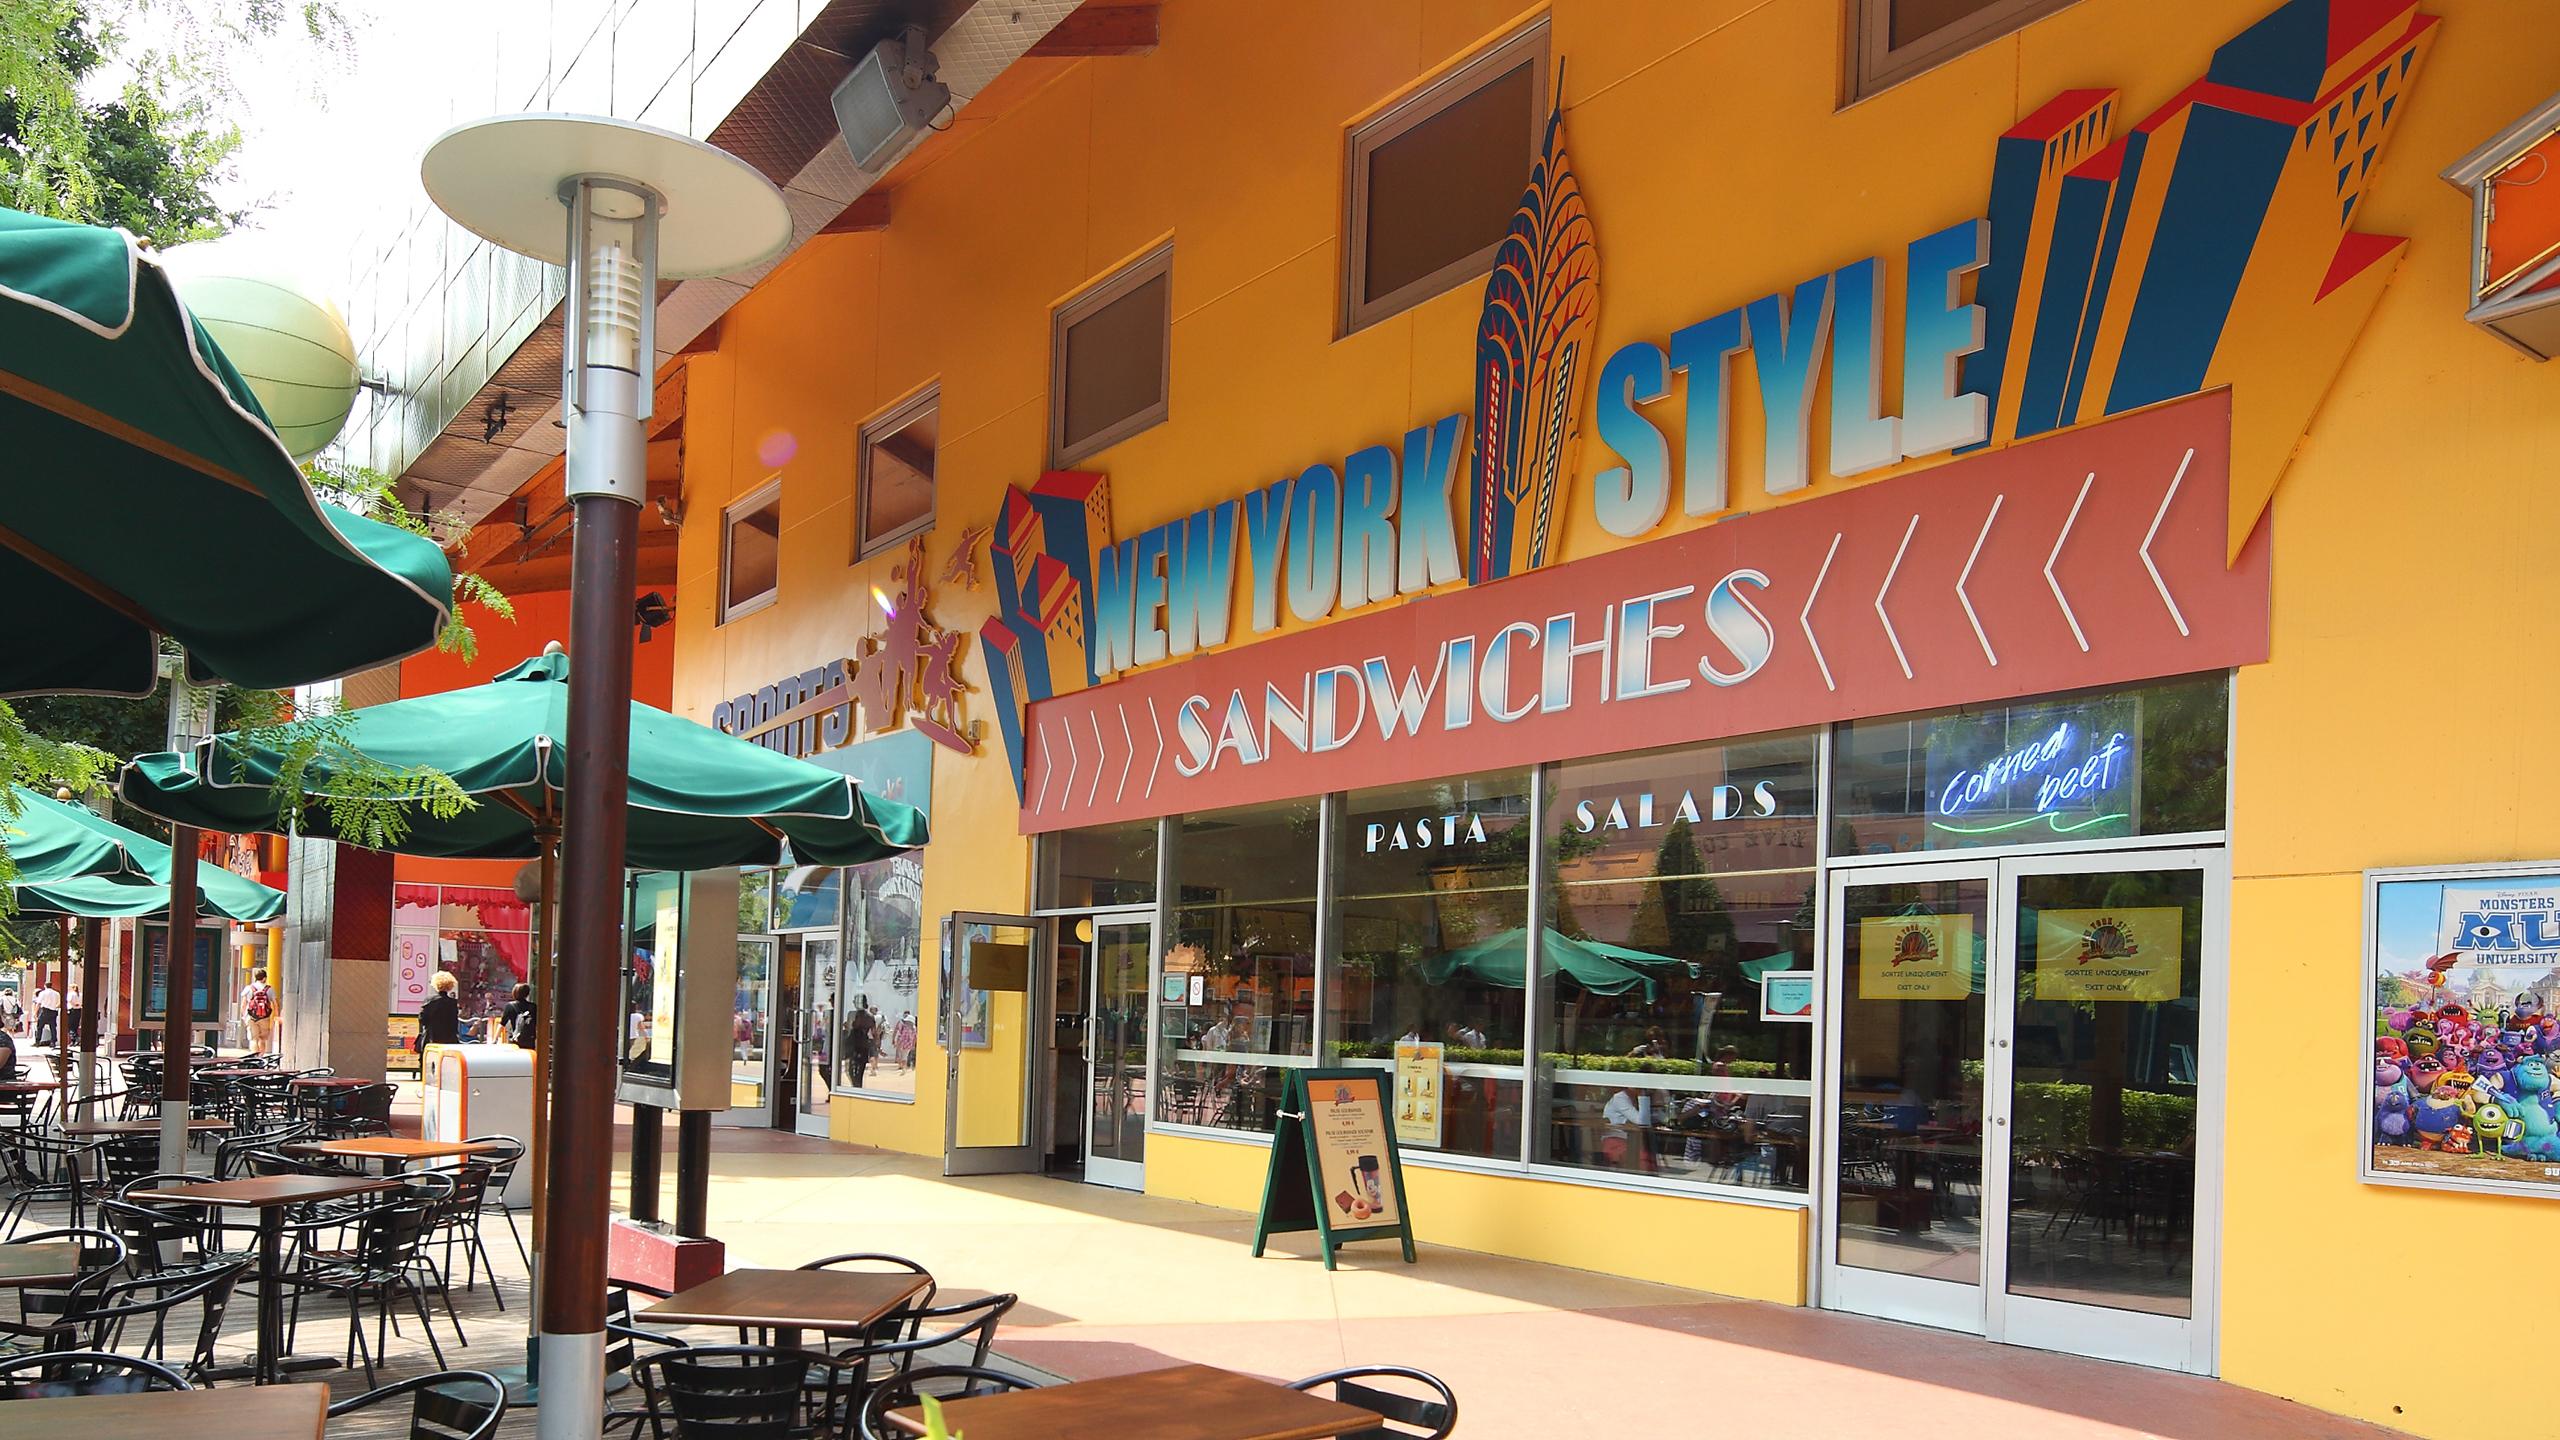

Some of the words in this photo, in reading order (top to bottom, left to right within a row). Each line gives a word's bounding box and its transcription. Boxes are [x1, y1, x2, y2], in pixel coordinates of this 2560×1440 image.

[1094, 499, 1241, 678] NEW
[1245, 413, 1470, 634] YORK
[1594, 218, 1991, 538] STYLE
[1175, 569, 1774, 777] SANDWICHES
[1940, 722, 2068, 816] Corned
[2036, 732, 2124, 813] beef
[1366, 813, 1487, 853] PASTA
[1576, 780, 1777, 834] SALADS
[2452, 909, 2560, 951] MU
[2480, 897, 2555, 910] MONSTERS
[2476, 952, 2558, 965] UNIVERSITY
